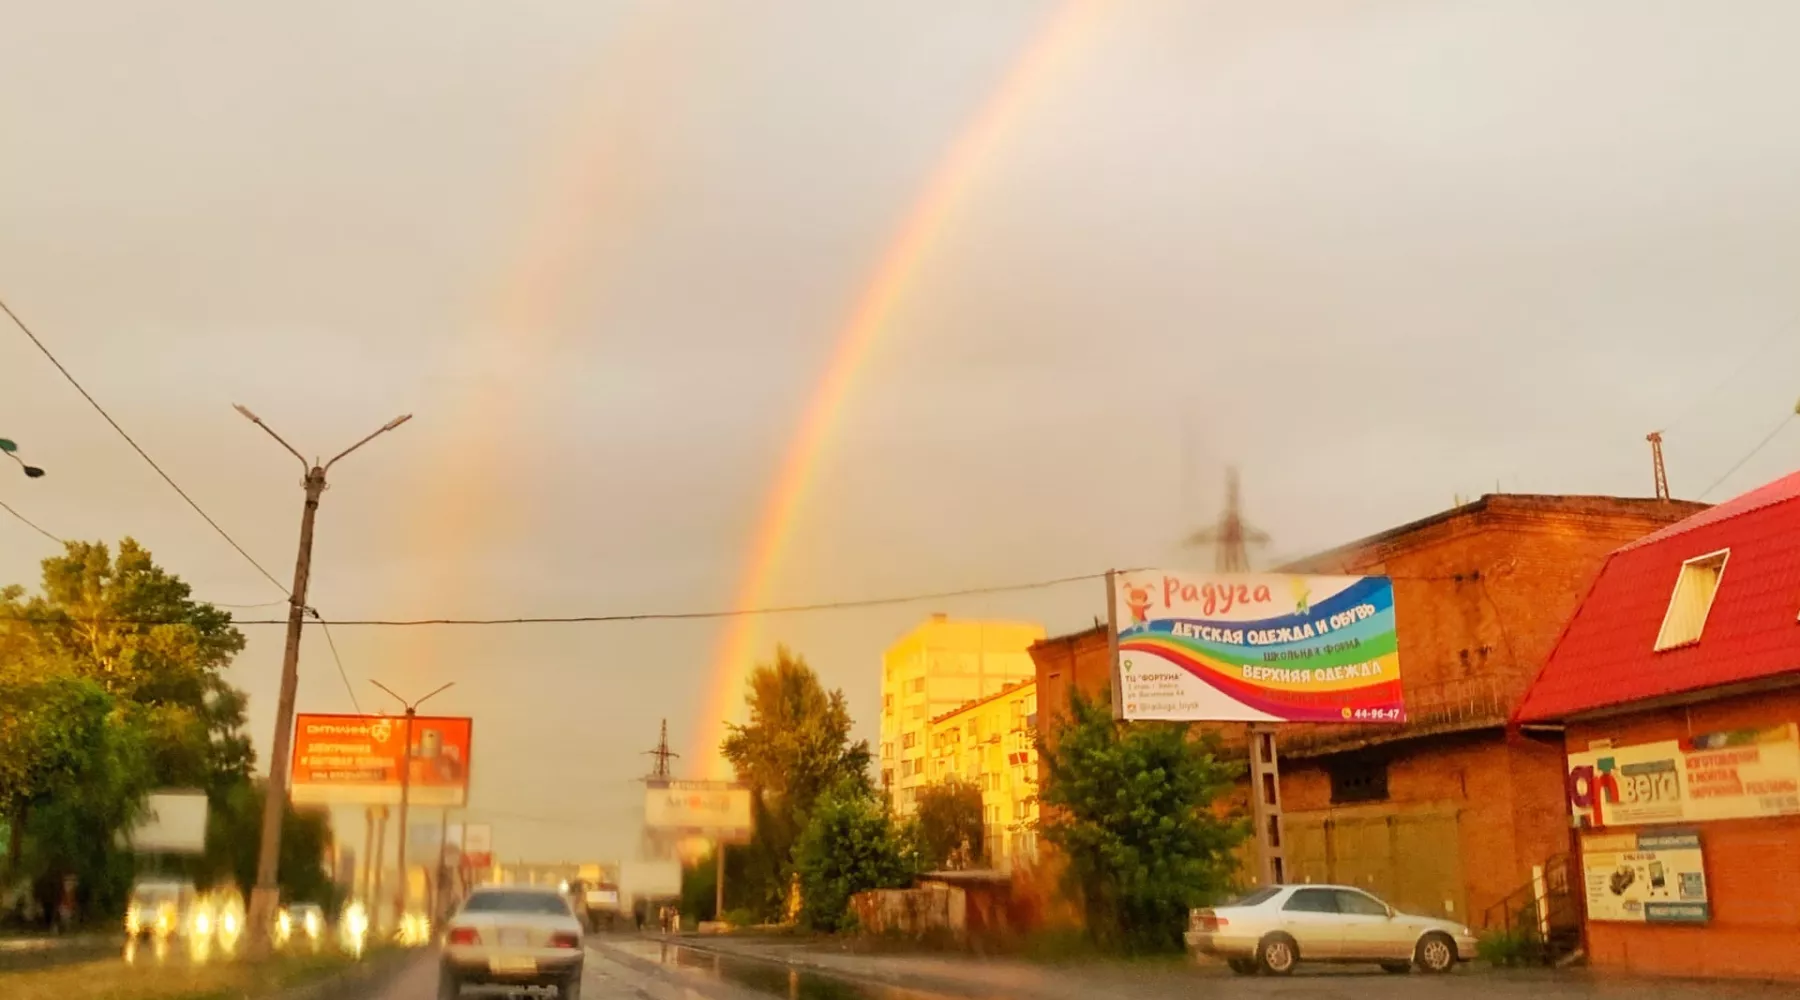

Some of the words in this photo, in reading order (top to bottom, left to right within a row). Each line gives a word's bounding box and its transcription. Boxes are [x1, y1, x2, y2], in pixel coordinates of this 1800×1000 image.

[1163, 576, 1271, 616] Радуга
[1171, 621, 1244, 645] ДЕТСКАЯ
[1247, 623, 1315, 645] ОДЕЖДА
[1316, 621, 1328, 634] И
[1330, 603, 1375, 630] ОБУВЬ
[1263, 647, 1320, 662] ШКОЛЬНАЯ
[1323, 637, 1361, 653] ФОРМА
[1242, 663, 1311, 683] ВЕРХНЯЯ
[1315, 661, 1382, 682] ОДЕЖДА
[1355, 709, 1399, 719] 44-96-47
